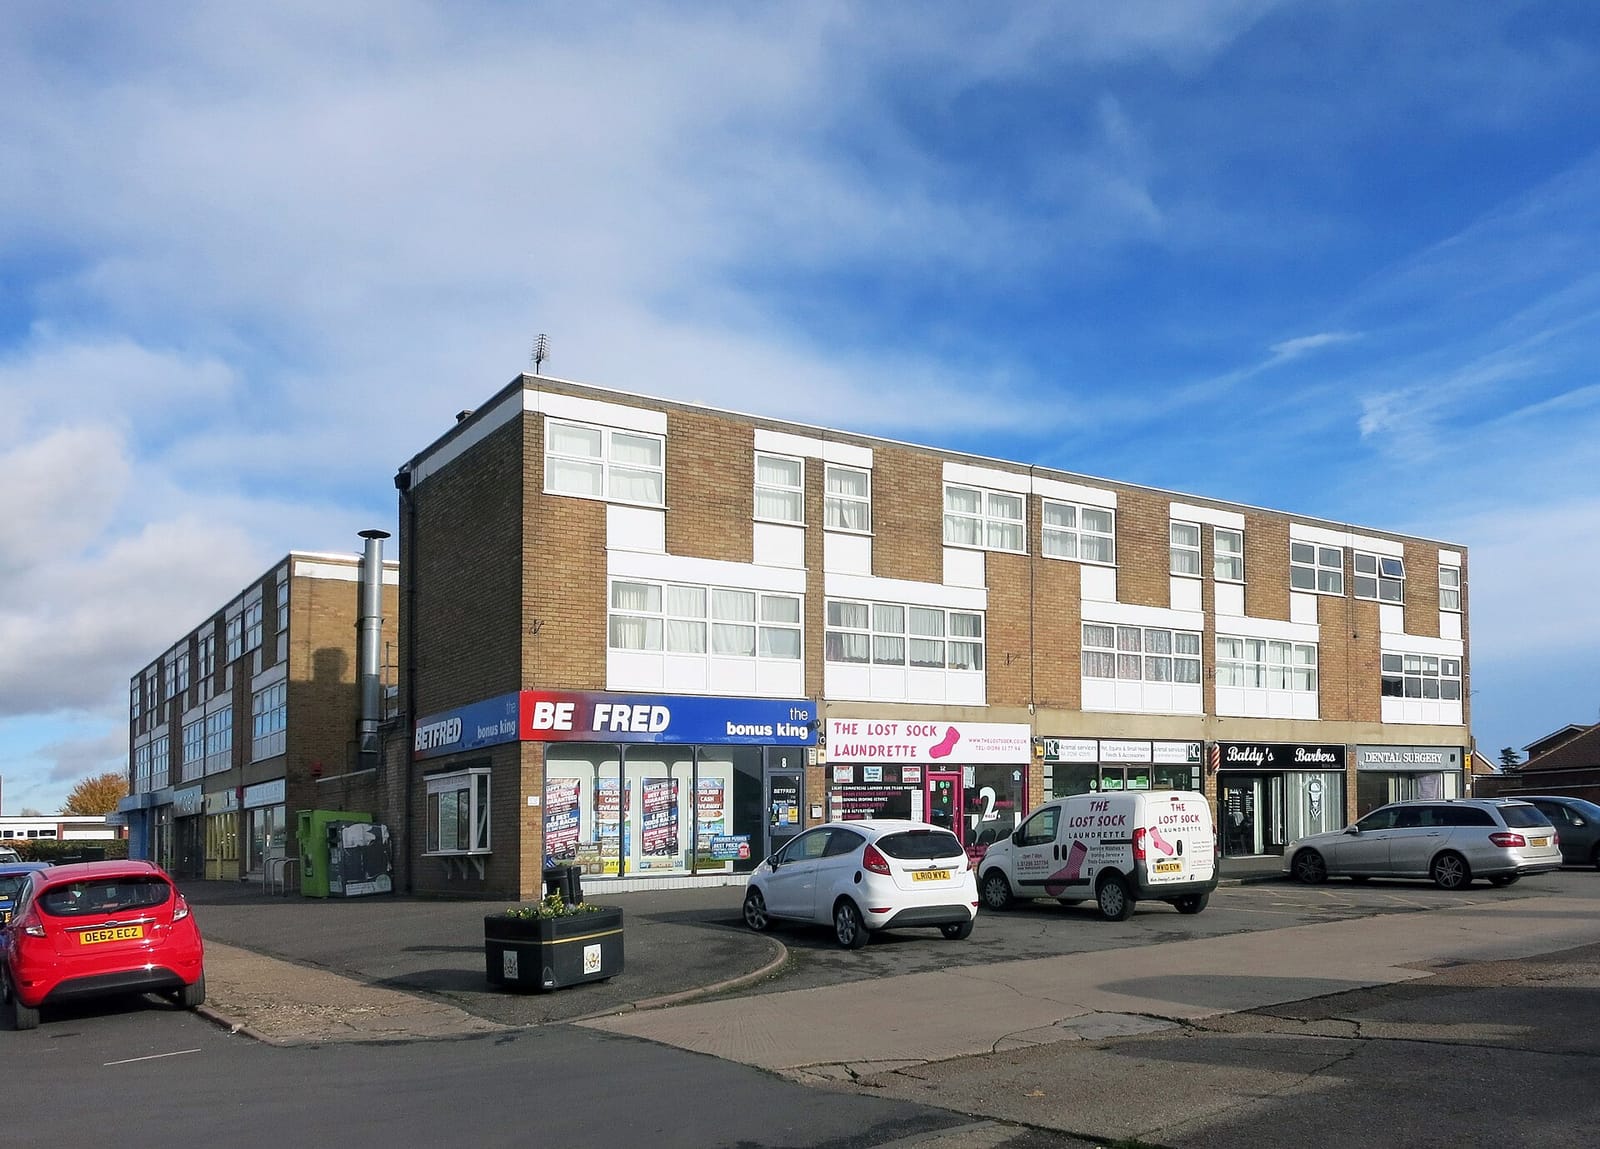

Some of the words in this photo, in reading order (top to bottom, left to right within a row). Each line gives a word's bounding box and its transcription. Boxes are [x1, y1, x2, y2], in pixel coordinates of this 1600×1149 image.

[532, 701, 575, 730] BE
[592, 704, 670, 731] FRED
[789, 707, 808, 720] the
[415, 717, 462, 752] BETFRED
[478, 724, 498, 739] bonus
[500, 719, 516, 736] king
[726, 721, 772, 736] bonus
[776, 722, 808, 740] king
[834, 722, 858, 735] THE
[868, 724, 898, 736] LOST
[906, 725, 937, 737] SOCK
[834, 743, 917, 757] LAUNDRETTE
[1226, 746, 1274, 766] Baldy's
[1294, 748, 1336, 762] Barbers
[782, 758, 787, 767] 8
[1365, 752, 1400, 763] DENTAL
[1403, 752, 1442, 764] SURGERY
[1090, 801, 1109, 812] THE
[1171, 803, 1186, 812] THE
[1069, 816, 1095, 827] LOST
[1097, 815, 1126, 827] SOCK
[1159, 815, 1177, 825] LOST
[1181, 814, 1200, 823] SOCK
[1068, 831, 1125, 839] LAUNDRETTE
[85, 931, 113, 942] OE62
[117, 928, 138, 938] ECZ
